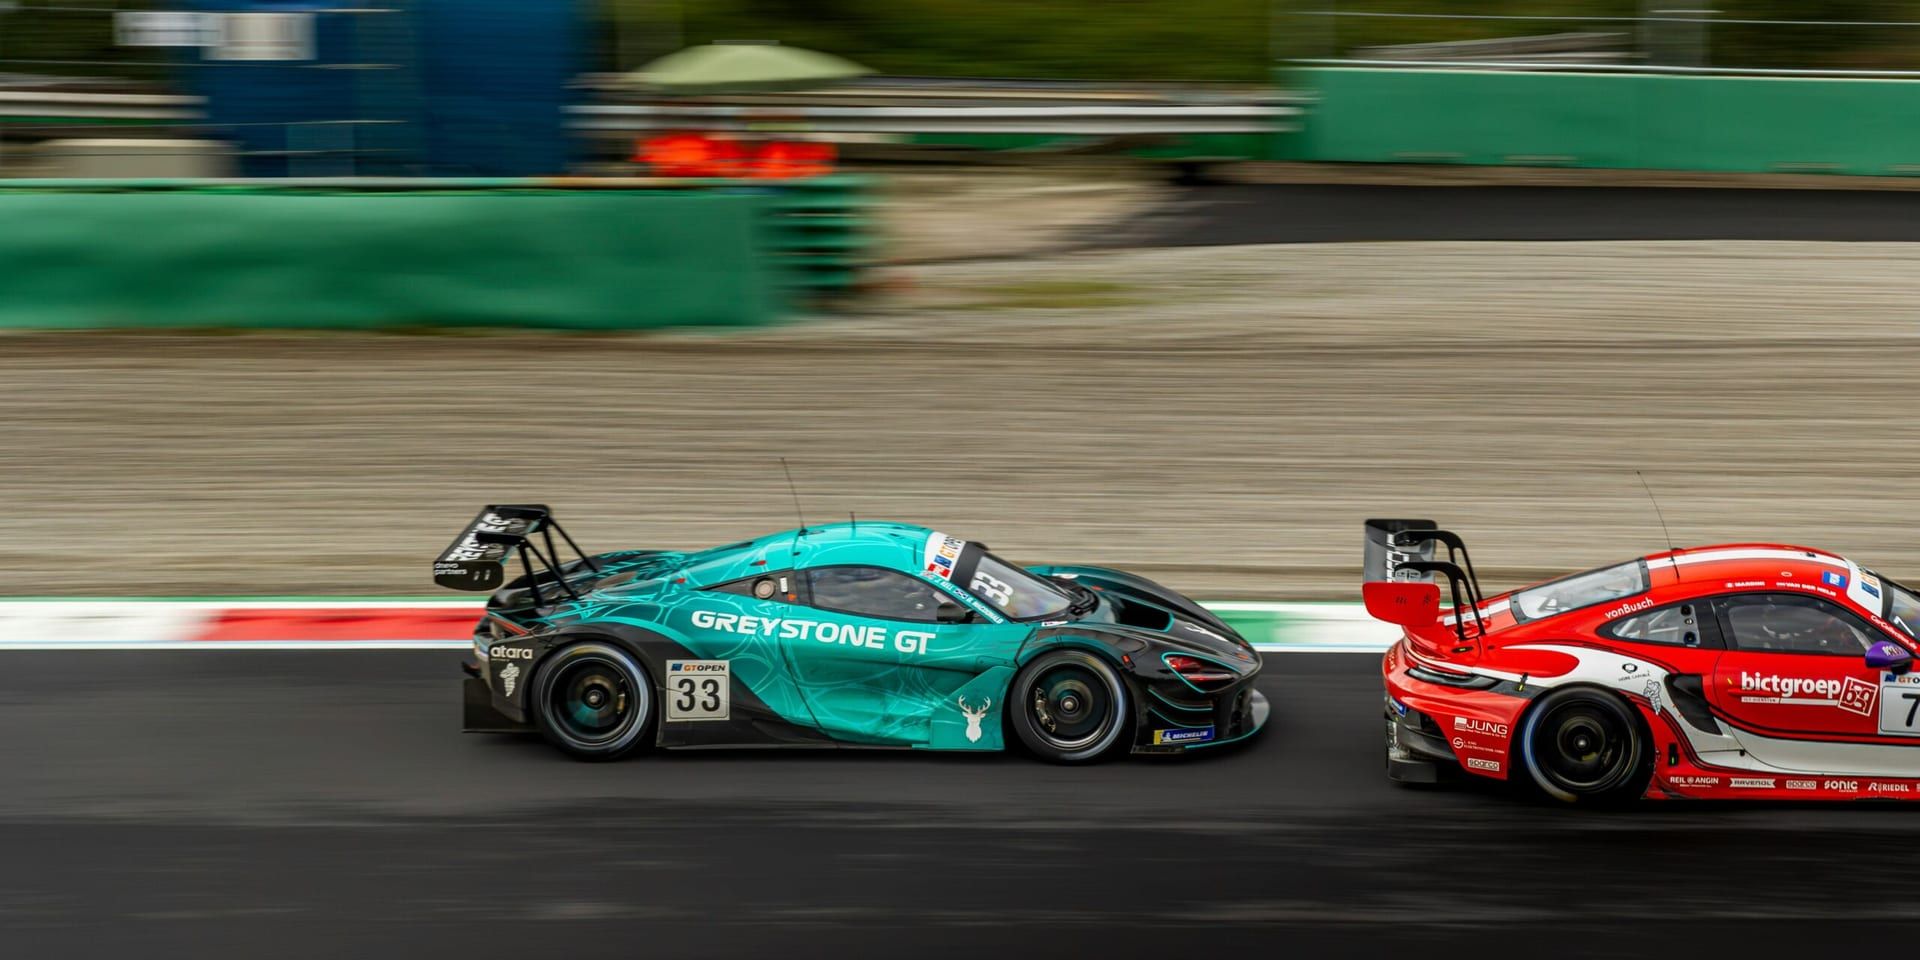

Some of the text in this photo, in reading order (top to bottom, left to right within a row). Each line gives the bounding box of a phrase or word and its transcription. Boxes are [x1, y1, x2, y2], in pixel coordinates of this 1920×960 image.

[970, 571, 1013, 607] 33
[1605, 597, 1654, 619] vonBusch
[691, 610, 936, 655] GREYSTONE GT
[490, 645, 533, 660] atara
[676, 678, 721, 712] 33
[1741, 671, 1841, 699] bictgroep
[1172, 730, 1208, 739] MICHELIN
[1466, 719, 1508, 734] JUNG
[1824, 781, 1858, 789] sonic
